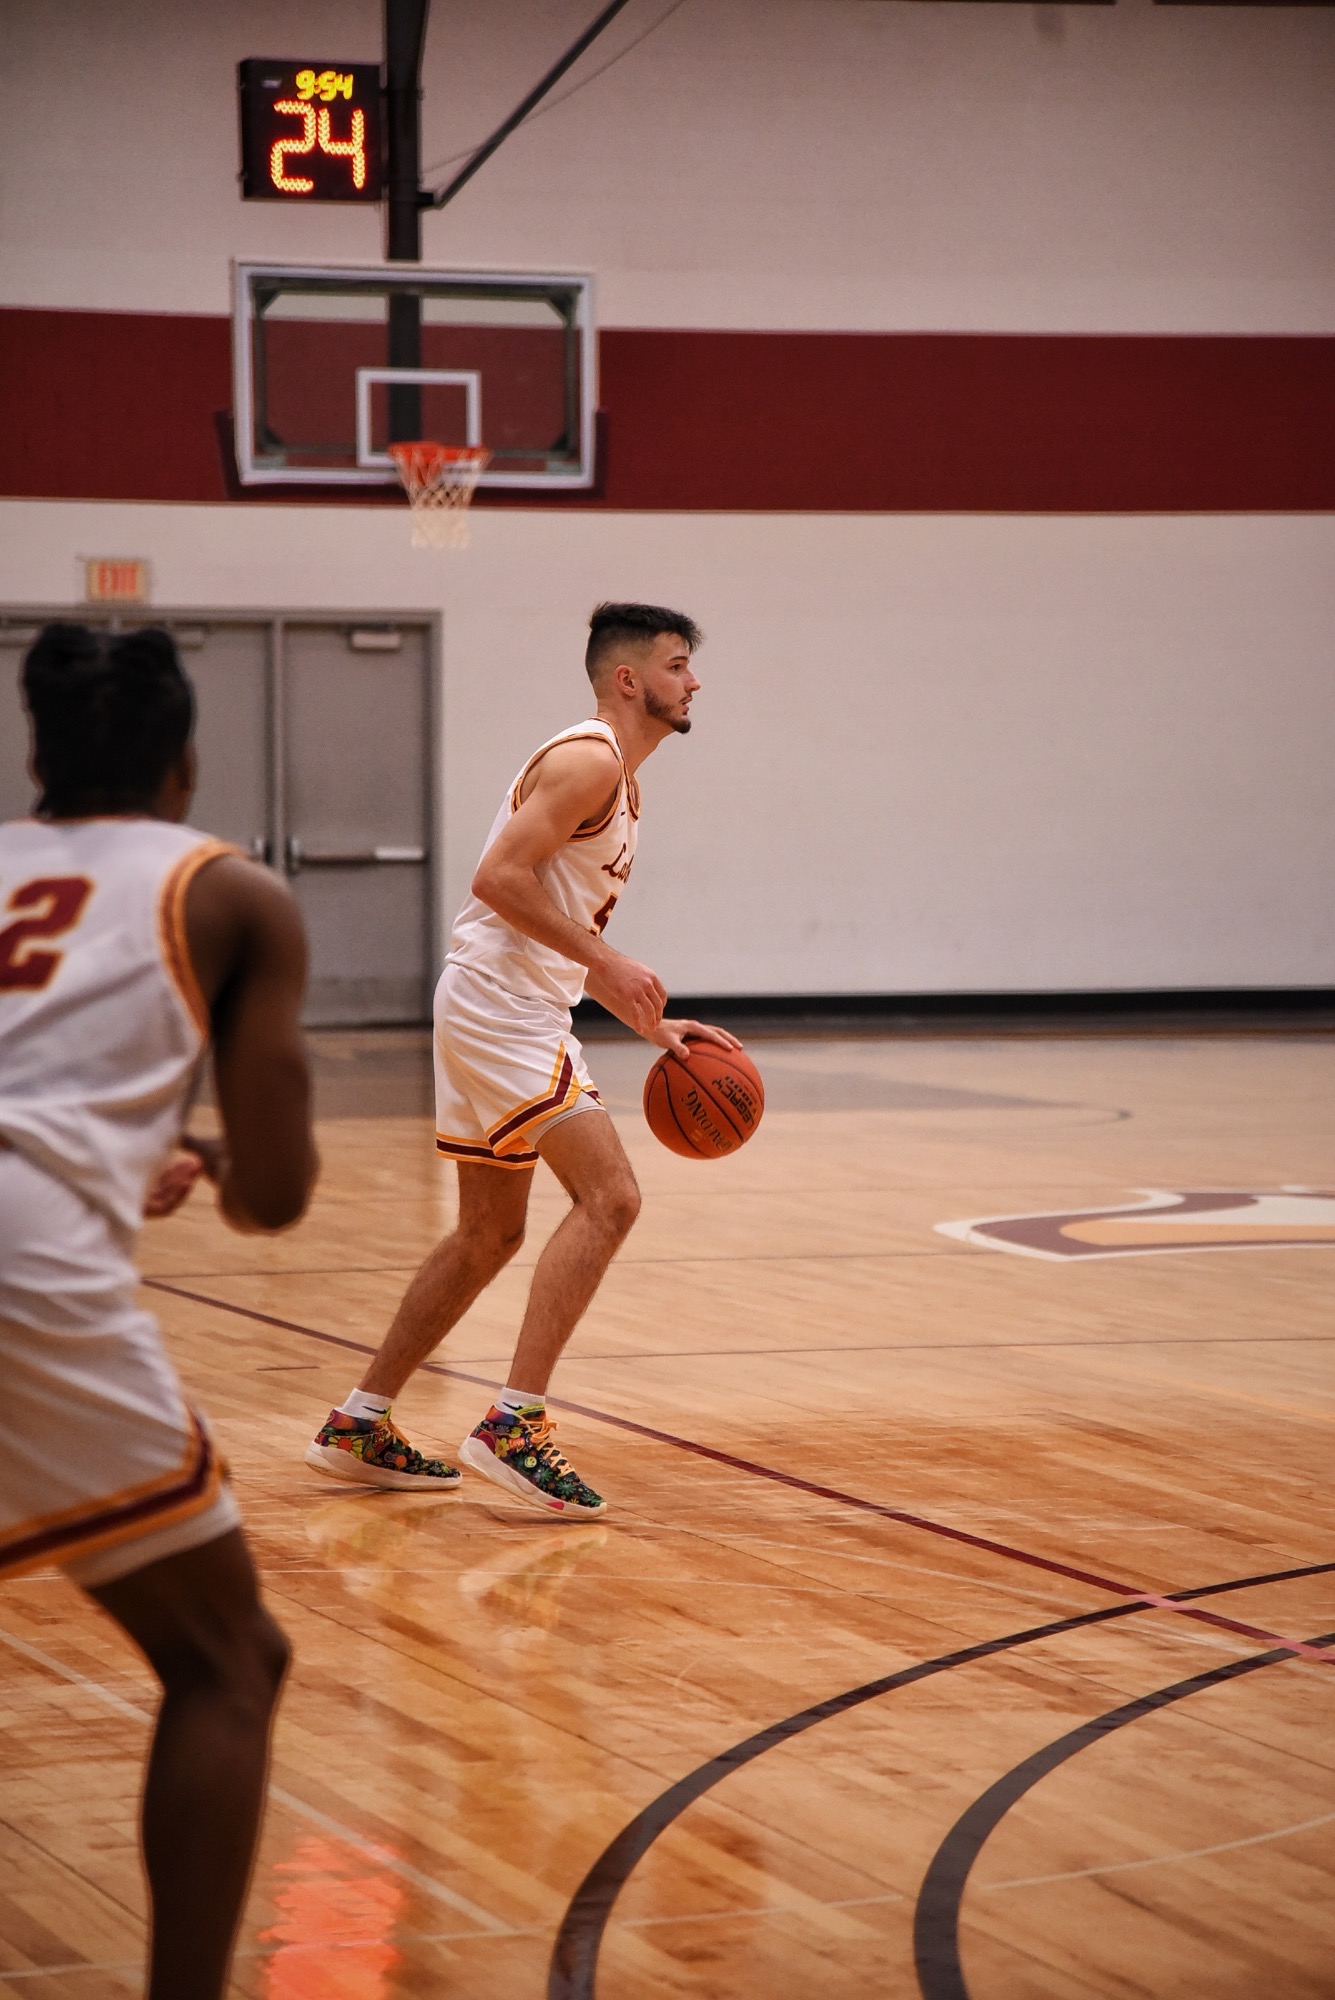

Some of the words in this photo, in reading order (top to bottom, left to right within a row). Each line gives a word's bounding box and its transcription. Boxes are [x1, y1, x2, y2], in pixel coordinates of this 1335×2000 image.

[296, 70, 353, 101] 9:54
[271, 101, 365, 191] 24
[0, 876, 94, 993] 2
[681, 1088, 734, 1152] PALDING
[712, 1079, 755, 1130] LEGACY
